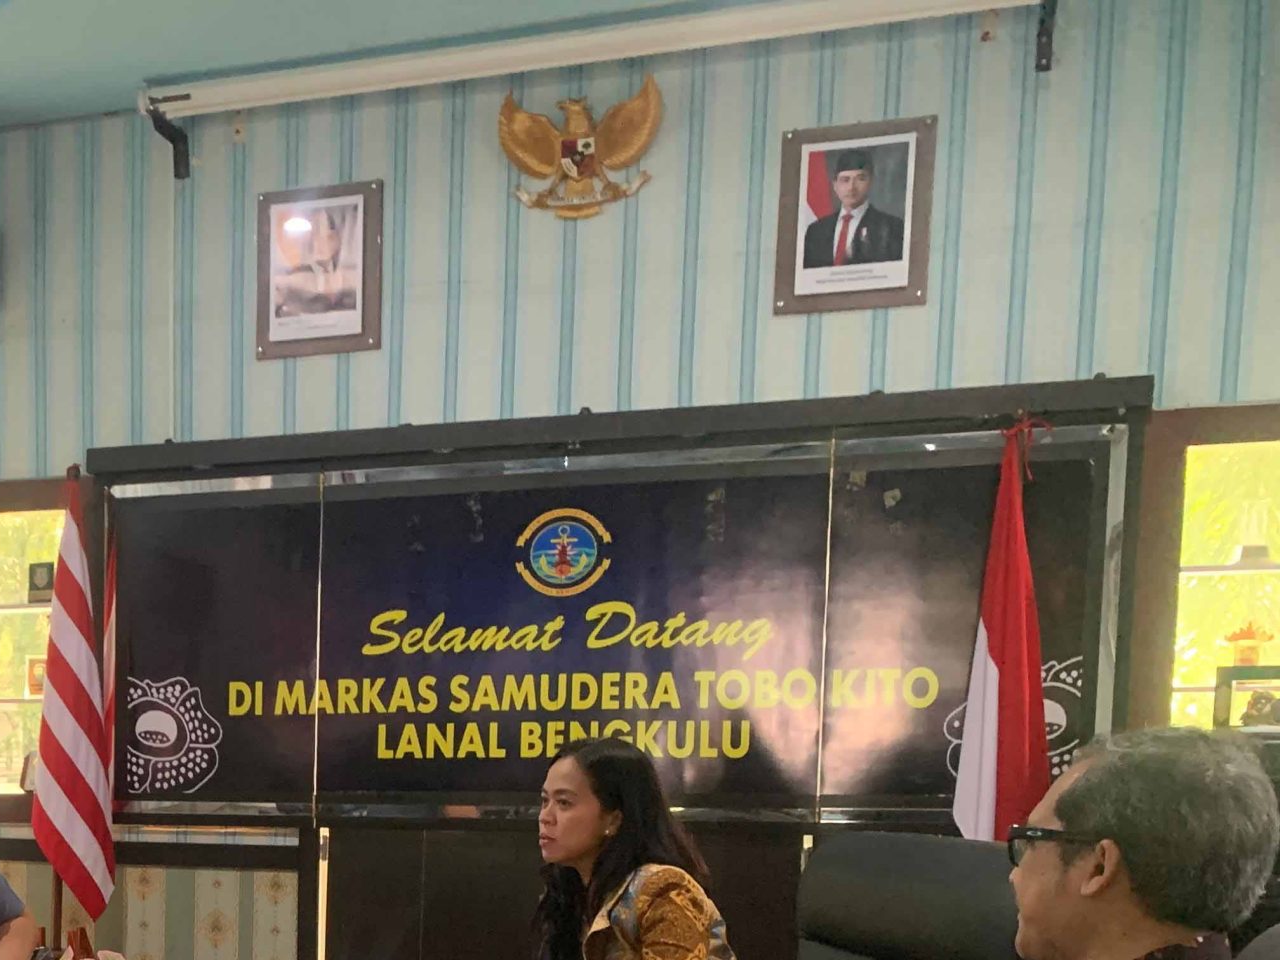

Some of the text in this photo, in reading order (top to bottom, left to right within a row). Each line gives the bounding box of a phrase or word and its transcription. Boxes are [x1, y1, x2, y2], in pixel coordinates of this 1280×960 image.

[362, 600, 773, 661] Selamat Datang
[228, 666, 939, 716] DI MARKAS SAMUDERA TOBO KITO
[377, 722, 506, 760] LANAL
